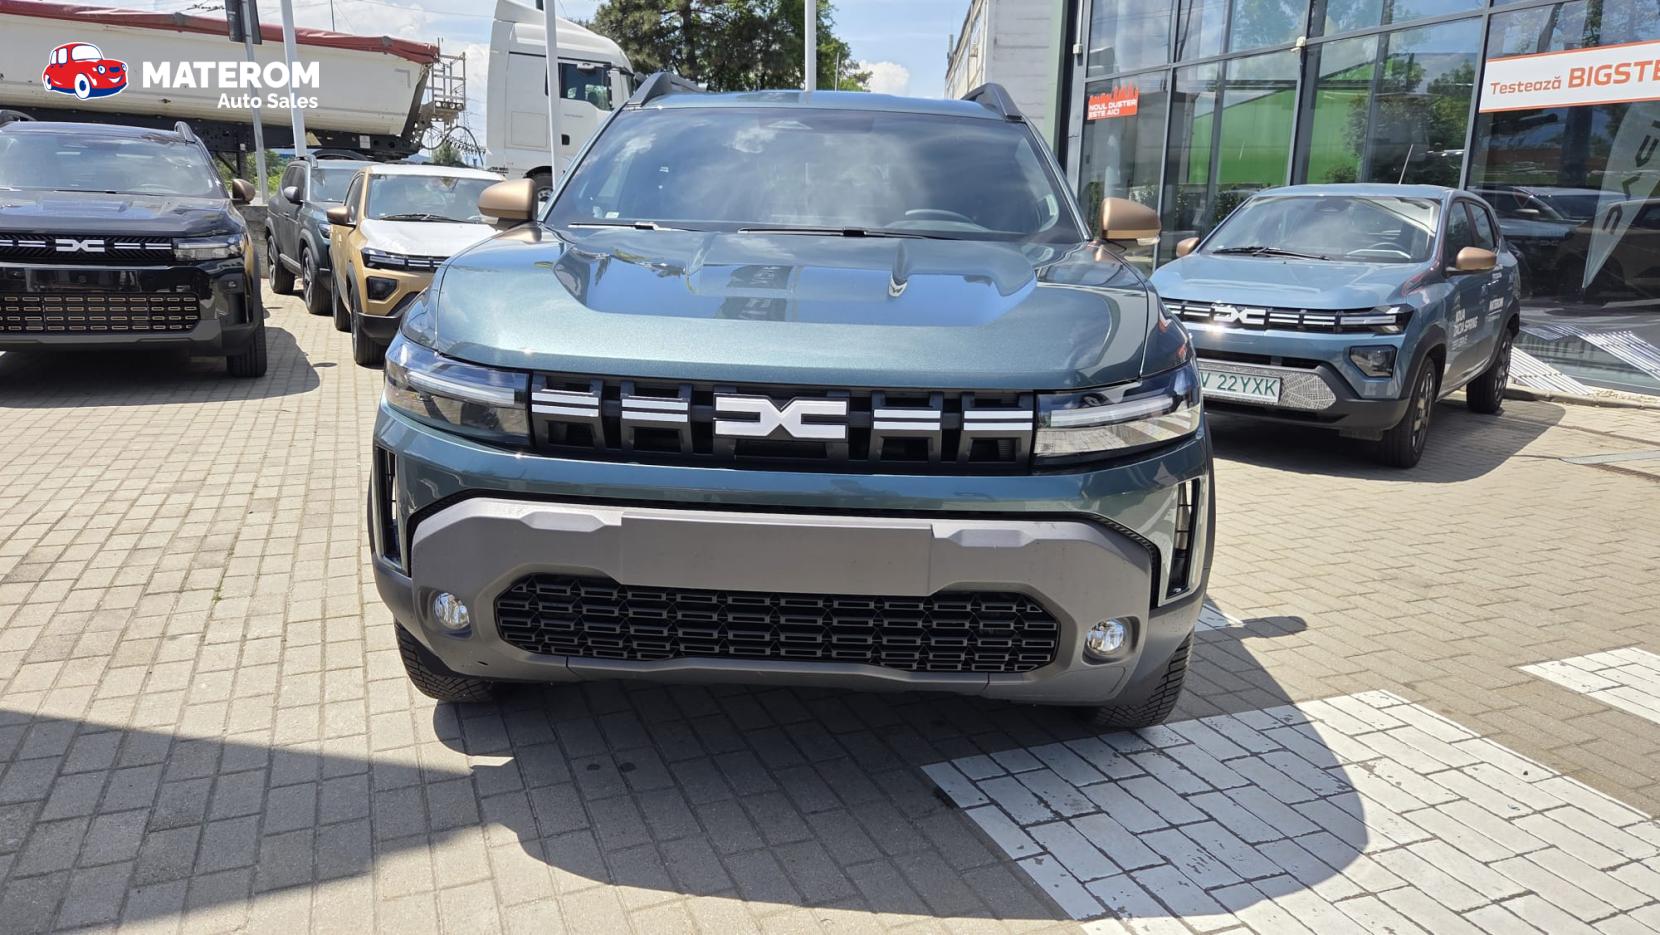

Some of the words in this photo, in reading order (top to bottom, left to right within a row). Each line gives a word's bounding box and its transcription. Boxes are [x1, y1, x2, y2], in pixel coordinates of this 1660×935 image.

[1491, 75, 1562, 95] Testează
[1089, 103, 1107, 112] NOUL
[1108, 99, 1137, 110] DUSTER
[1088, 110, 1106, 119] ESTE
[1217, 374, 1277, 396] 22YXK
